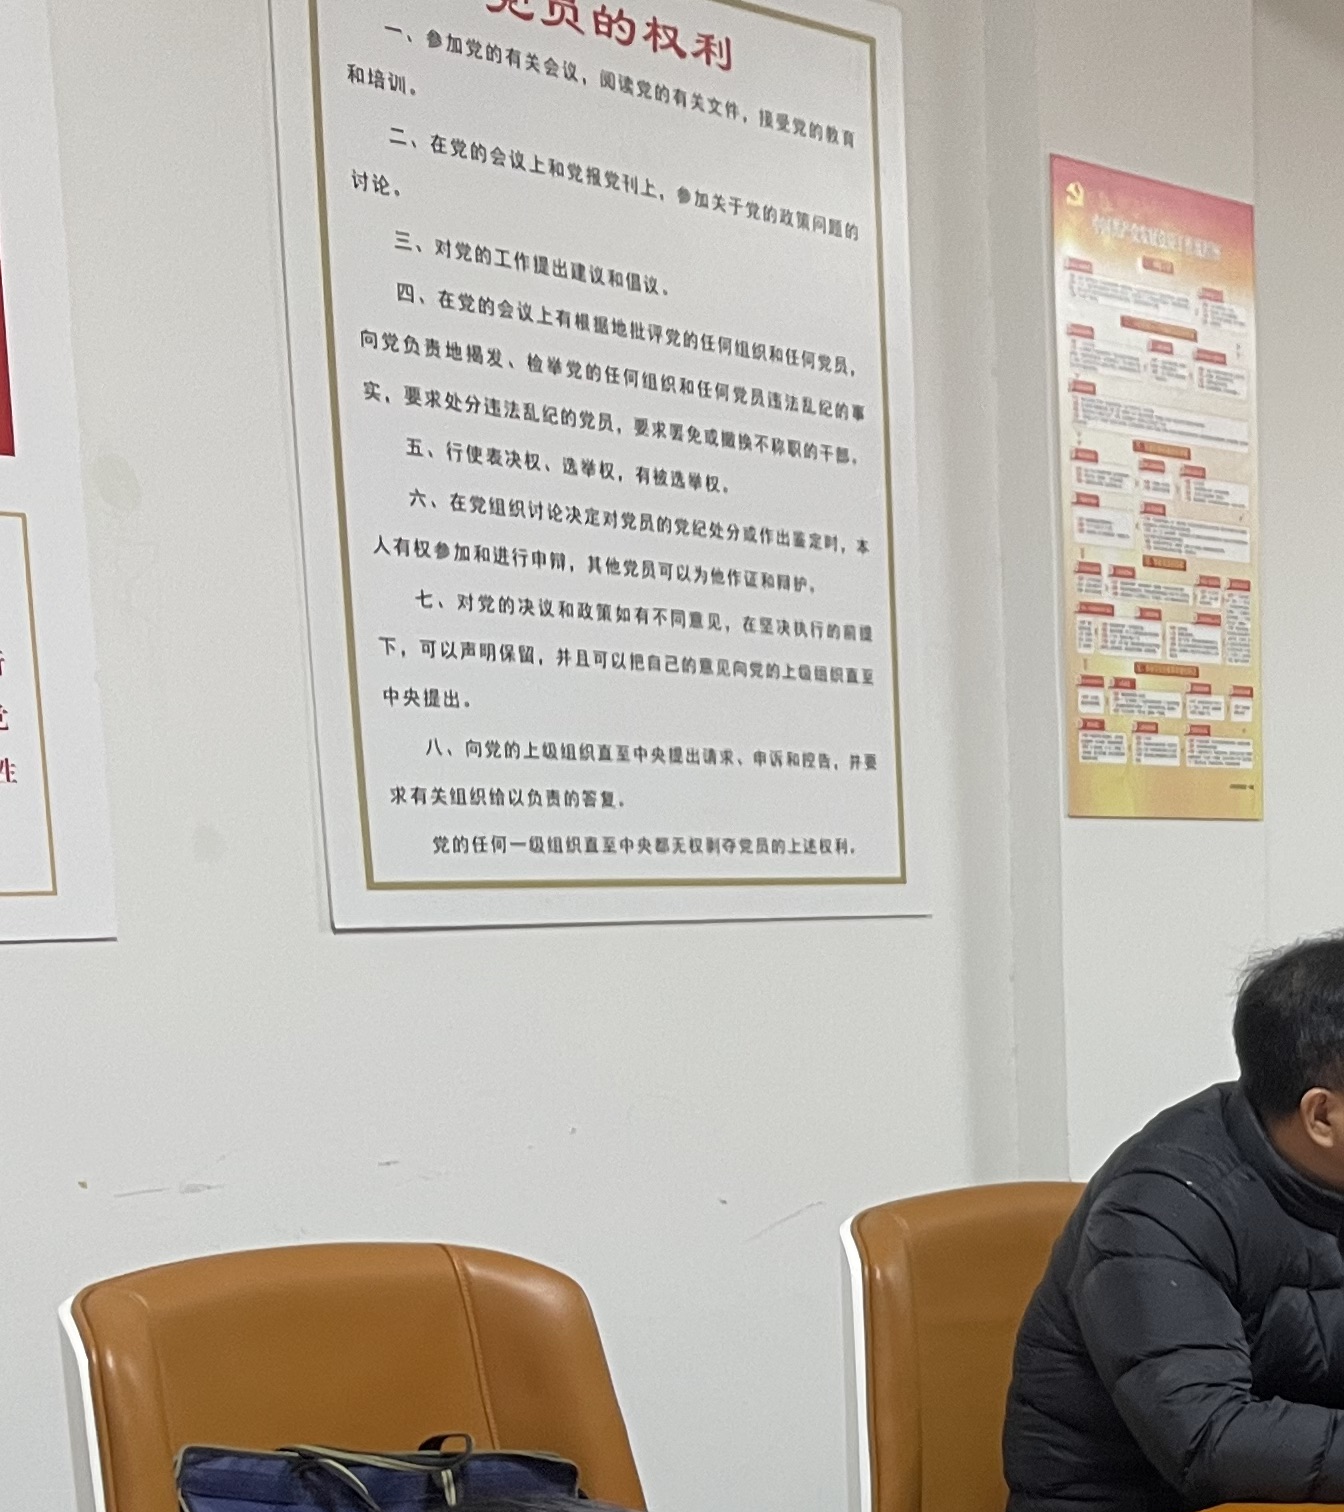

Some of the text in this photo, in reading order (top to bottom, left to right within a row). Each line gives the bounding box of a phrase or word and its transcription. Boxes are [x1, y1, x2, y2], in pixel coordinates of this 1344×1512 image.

[347, 63, 416, 95] 和培训。
[351, 168, 400, 196] 讨论。
[394, 230, 669, 296] 三、对党的工作提出建议和倡议。
[405, 437, 729, 494] 五、行使表决权、选举权，有被选举权。
[382, 686, 470, 709] 中央提出。
[390, 786, 625, 809] 求有关组织给以负责的答复。
[432, 835, 855, 855] 党的任何一级组织直至中央都无权剥夺党员的上述权利。
